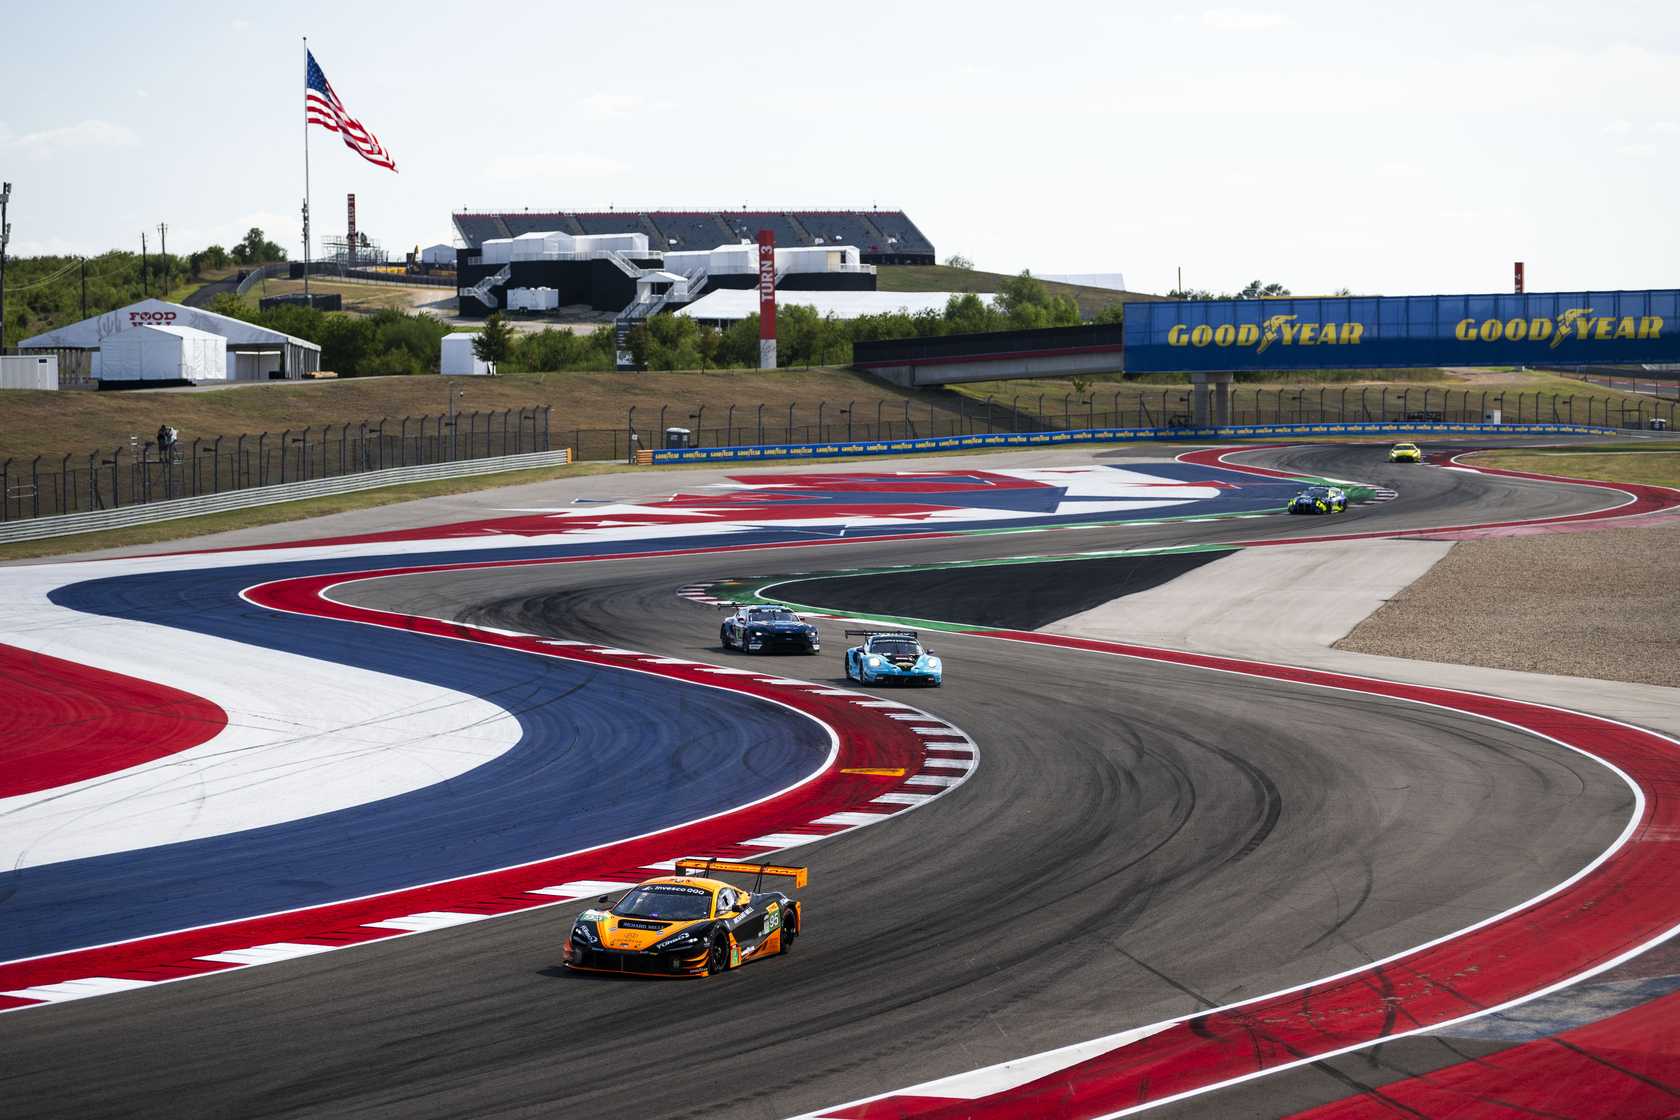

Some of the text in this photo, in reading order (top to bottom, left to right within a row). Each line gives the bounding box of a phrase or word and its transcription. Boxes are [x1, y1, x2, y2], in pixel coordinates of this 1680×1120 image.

[761, 245, 774, 303] TURN 3
[129, 311, 177, 321] FOOD
[1455, 315, 1664, 342] GOODYEAR
[1168, 322, 1364, 347] GOODYEAR
